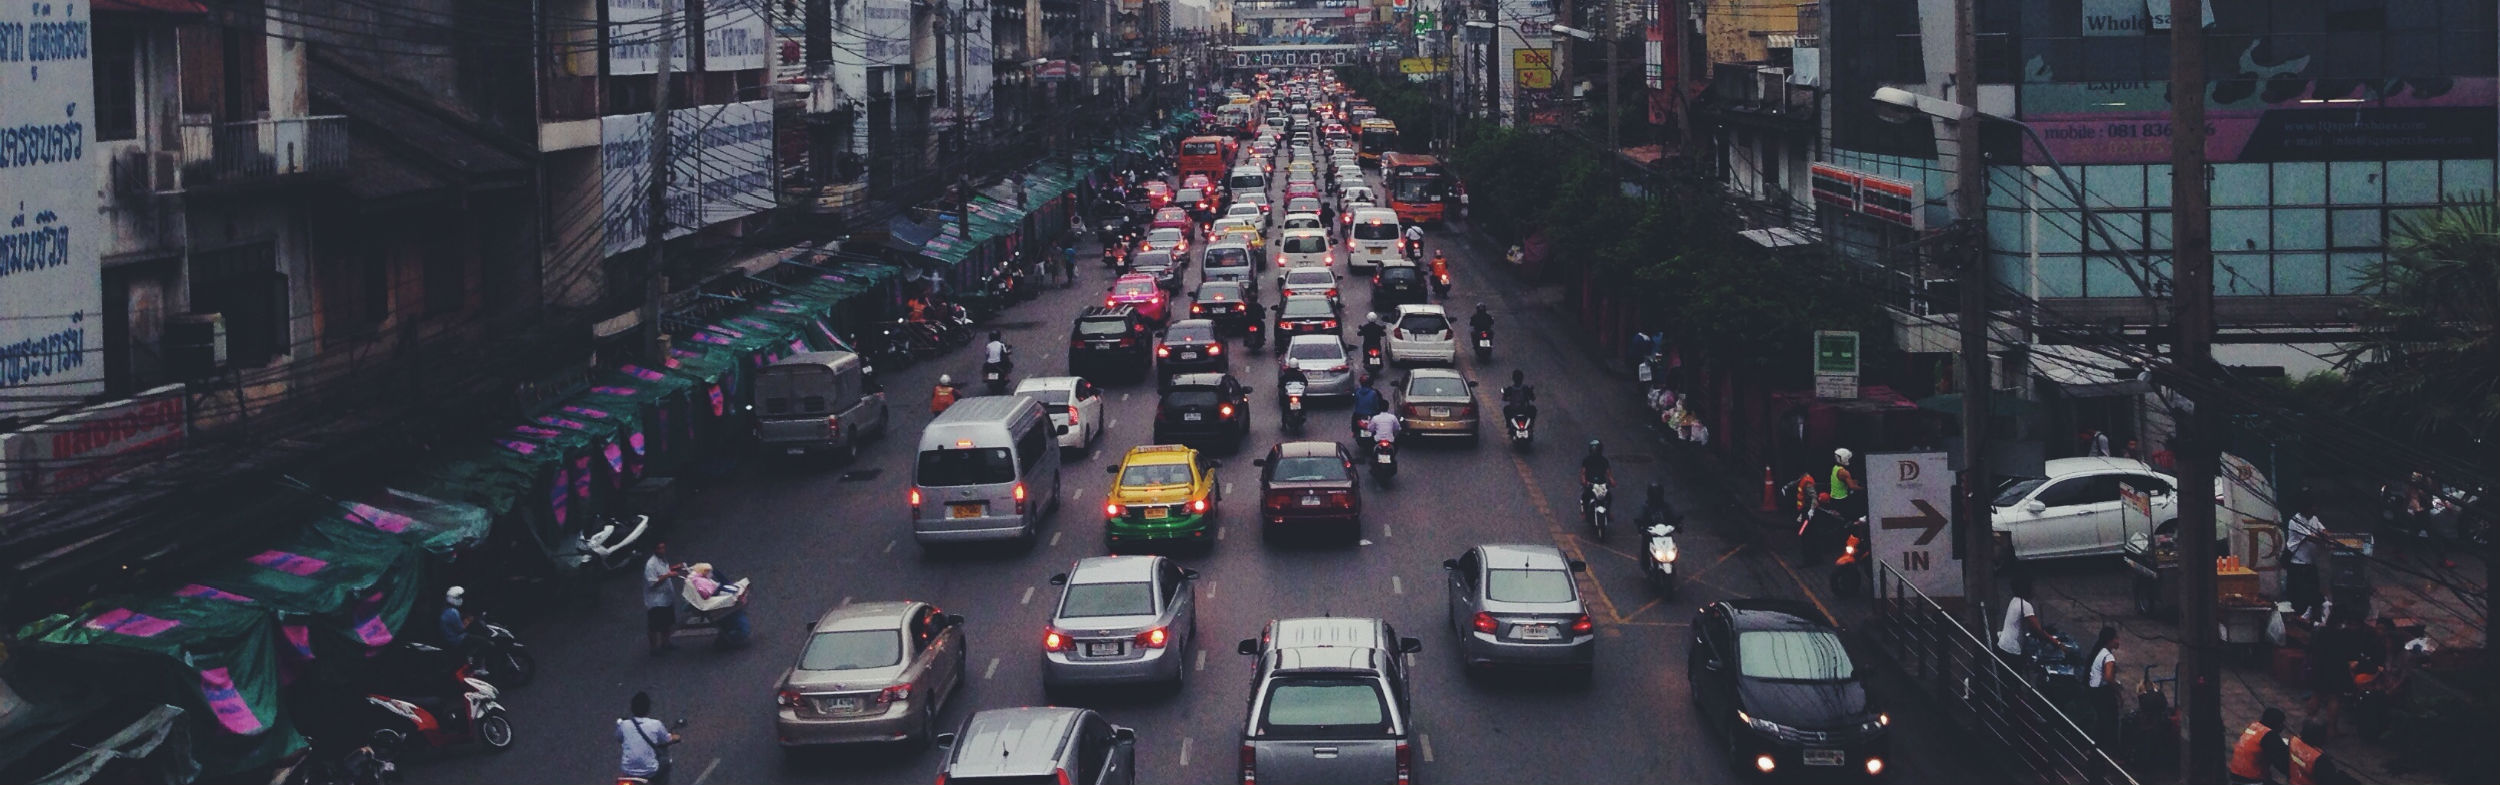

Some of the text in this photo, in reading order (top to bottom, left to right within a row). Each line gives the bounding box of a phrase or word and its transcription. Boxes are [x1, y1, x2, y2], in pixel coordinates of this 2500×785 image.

[2045, 125, 2095, 140] mobile
[2107, 123, 2137, 137] 081
[1902, 550, 1930, 571] IN
